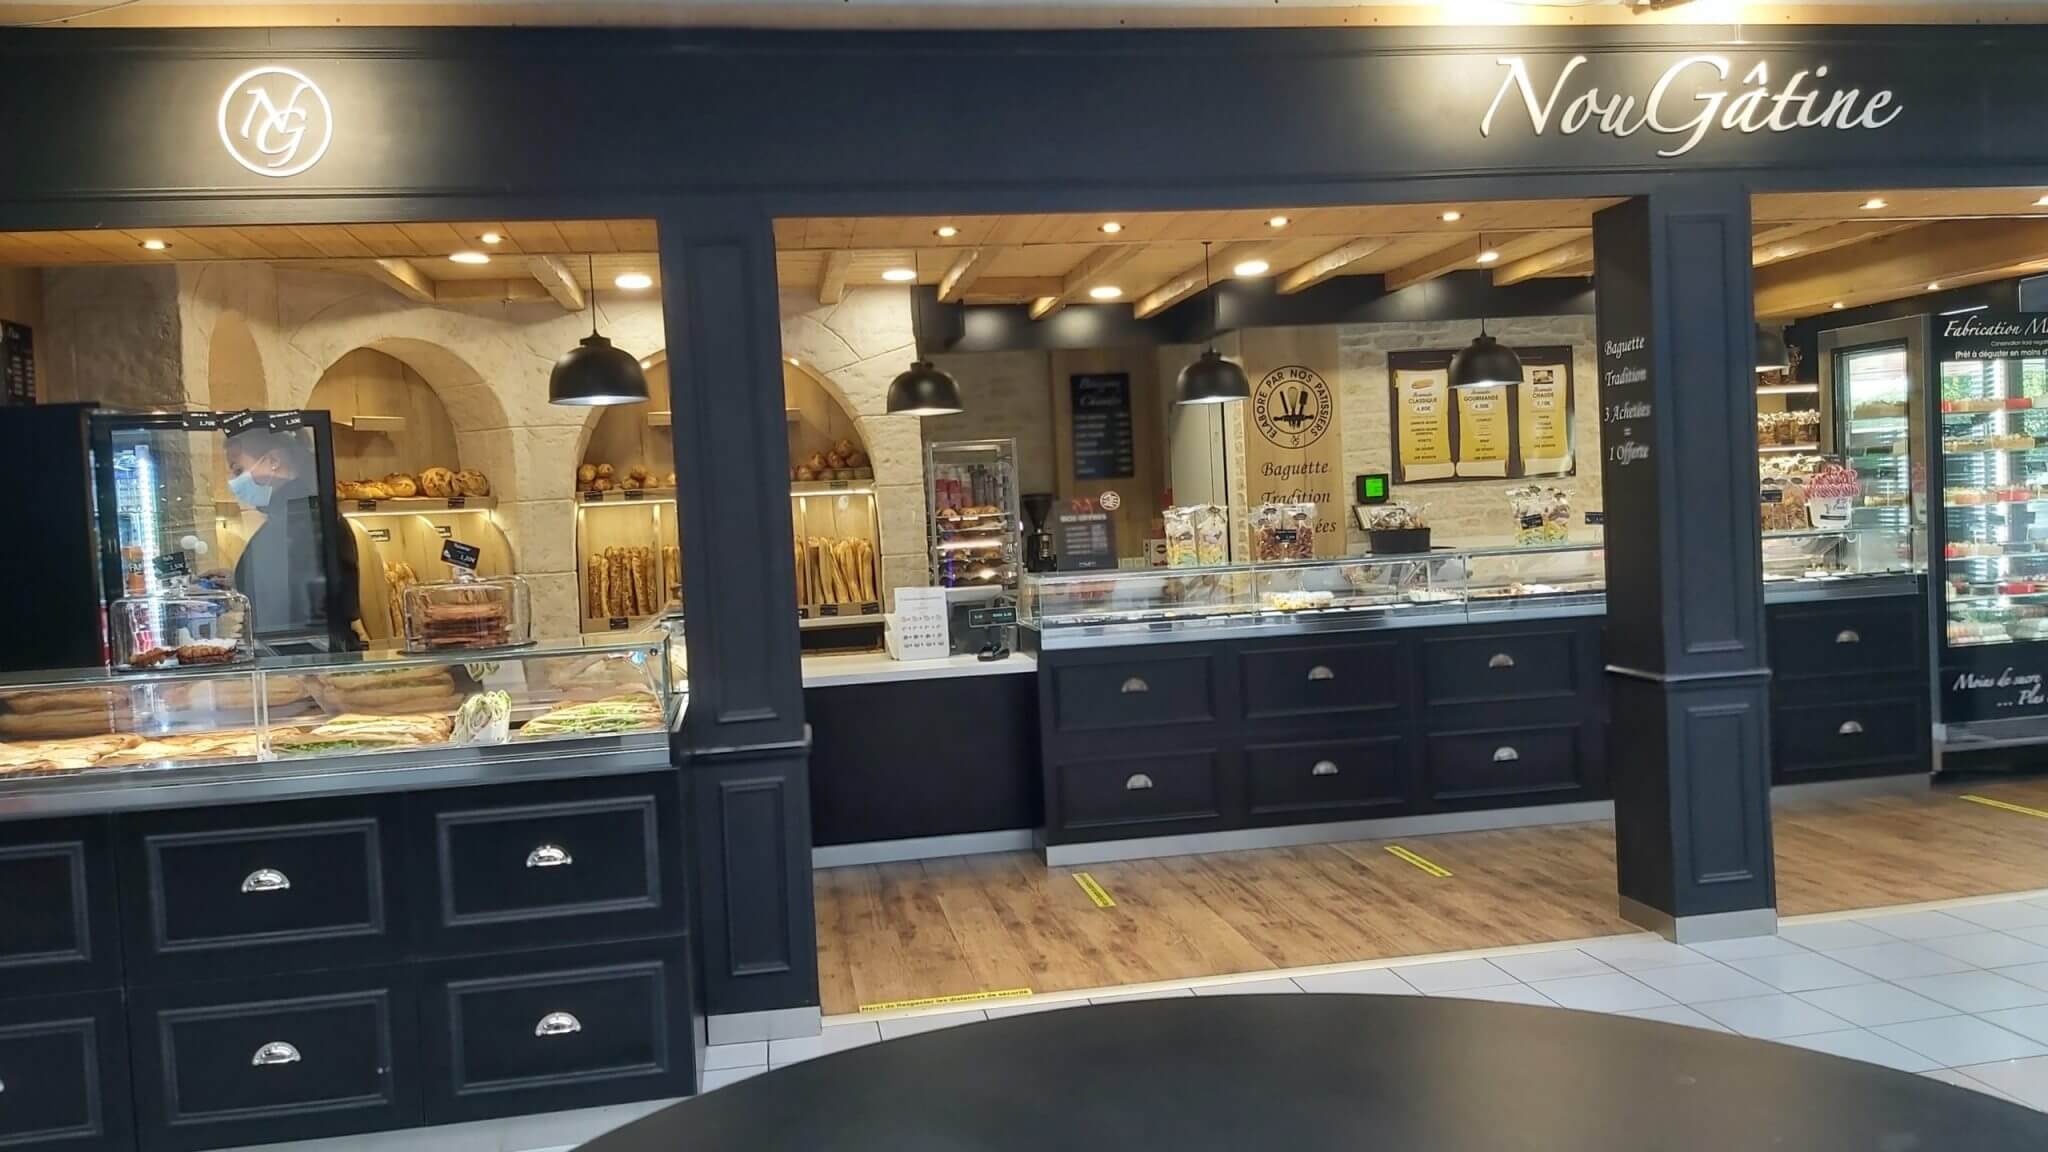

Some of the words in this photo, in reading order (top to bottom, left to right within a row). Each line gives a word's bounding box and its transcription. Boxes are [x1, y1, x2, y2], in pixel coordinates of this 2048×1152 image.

[1480, 55, 1903, 158] NouGâtine
[240, 81, 309, 168] NG
[1943, 315, 2022, 337] Fabrication
[1603, 336, 1646, 359] Baguette
[1265, 371, 1285, 390] PAR
[1290, 368, 1313, 384] NOS
[1604, 366, 1647, 387] Tradition
[1255, 391, 1278, 440] ELABORE
[1311, 382, 1331, 438] PATISSIERS
[1604, 407, 1610, 422] 3
[1623, 427, 1632, 436] =
[1609, 446, 1615, 461] 1
[1616, 440, 1650, 465] Offerte
[1261, 461, 1329, 481] Baguette
[1260, 488, 1331, 506] Tradition
